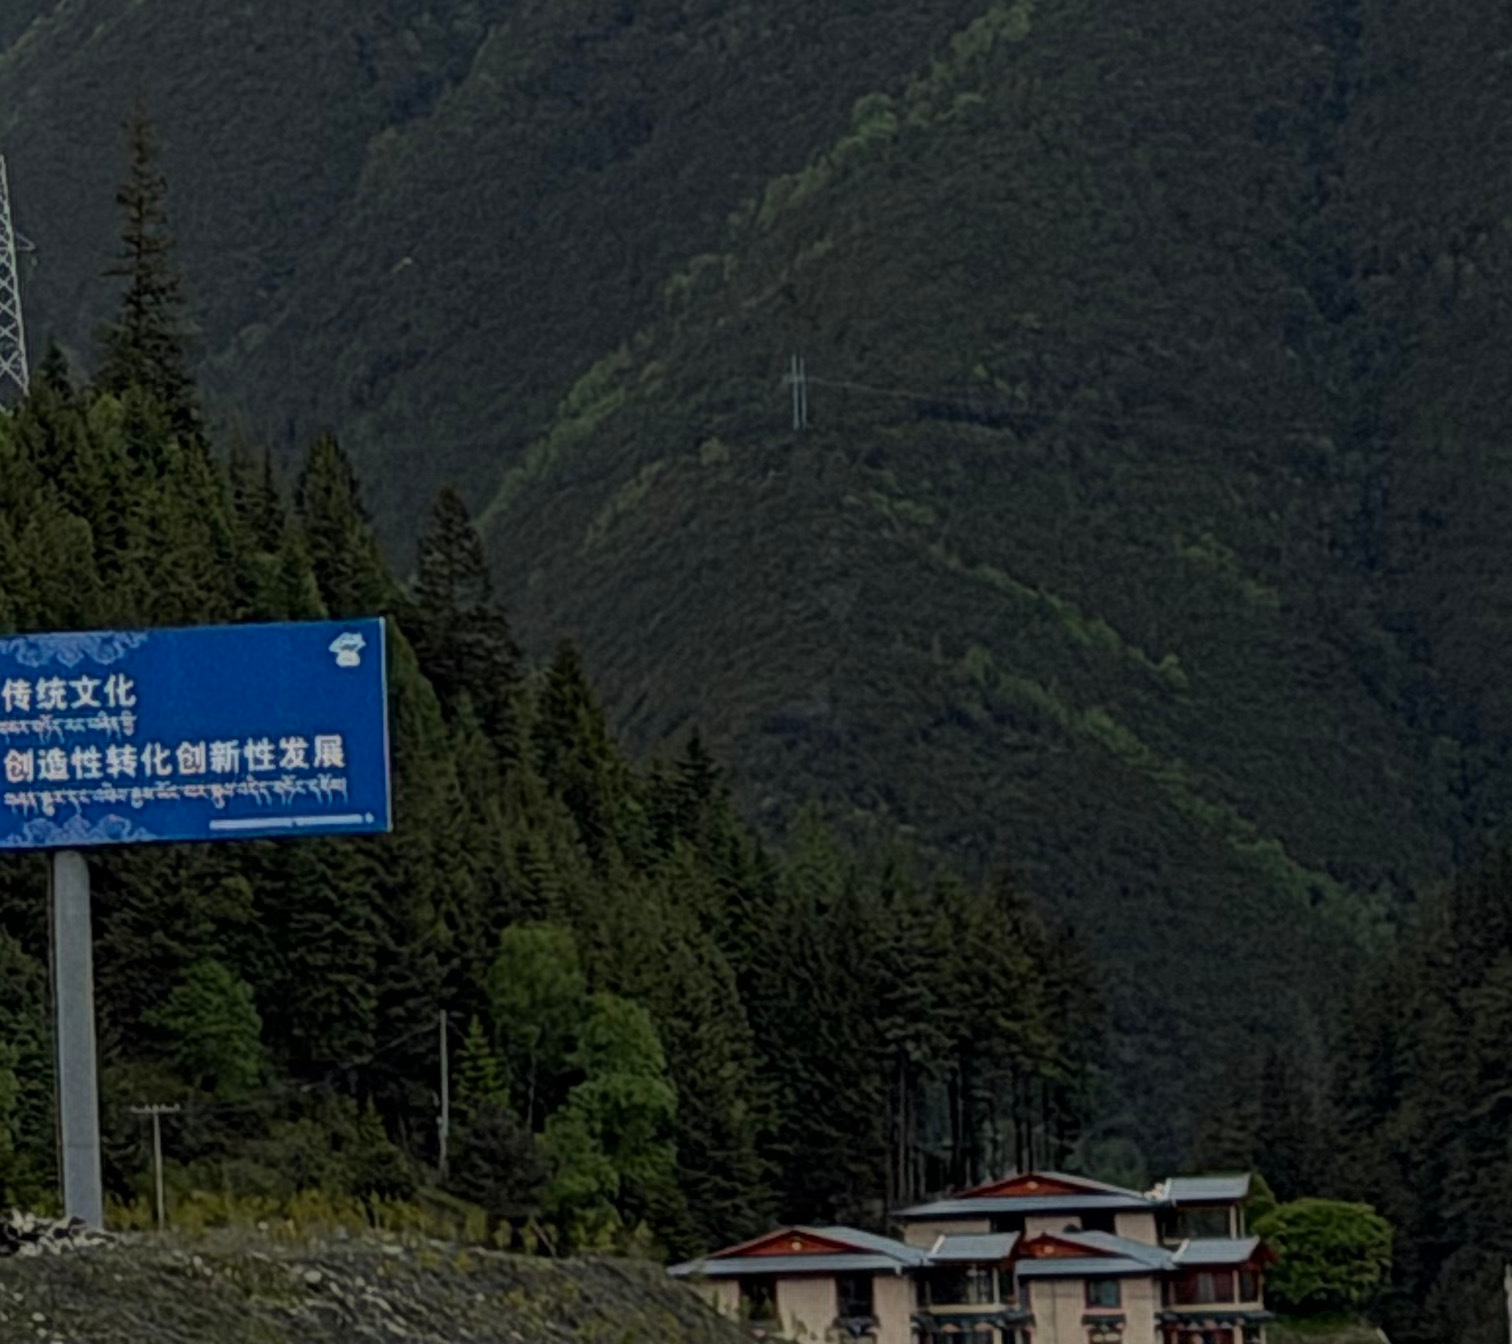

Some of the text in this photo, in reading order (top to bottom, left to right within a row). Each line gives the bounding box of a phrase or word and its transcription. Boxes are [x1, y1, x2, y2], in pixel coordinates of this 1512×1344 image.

[3, 734, 346, 783] 创造性转化创新性发展
